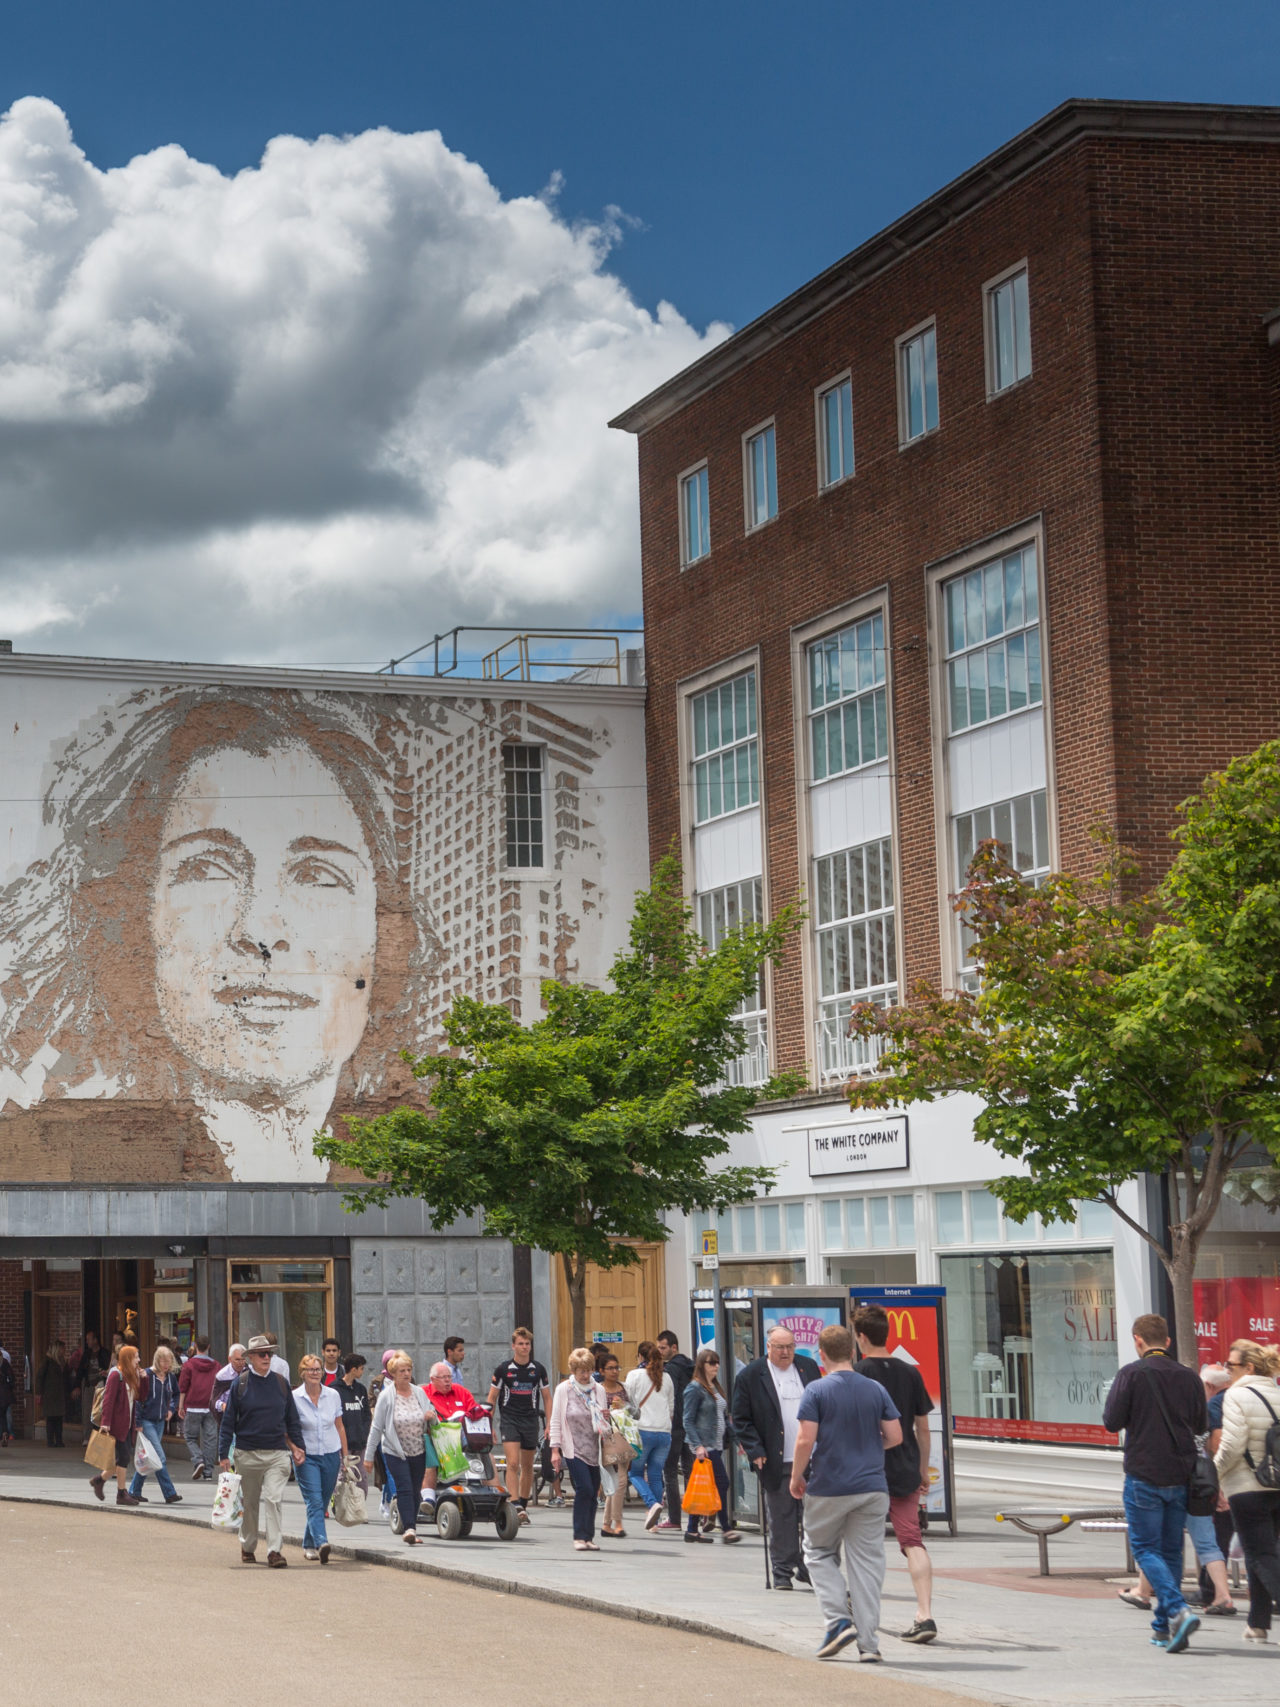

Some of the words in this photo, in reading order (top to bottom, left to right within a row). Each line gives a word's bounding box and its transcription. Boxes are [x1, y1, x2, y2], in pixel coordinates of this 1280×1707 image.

[815, 1138, 829, 1151] THE
[831, 1134, 857, 1149] WHITE
[858, 1129, 899, 1146] COMPANY
[846, 1153, 867, 1162] LONDON
[884, 1288, 911, 1296] Internet
[1062, 1289, 1084, 1306] THE
[1085, 1289, 1115, 1306] WHIT
[1249, 1318, 1275, 1332] SALE
[794, 1331, 818, 1345] GHTY
